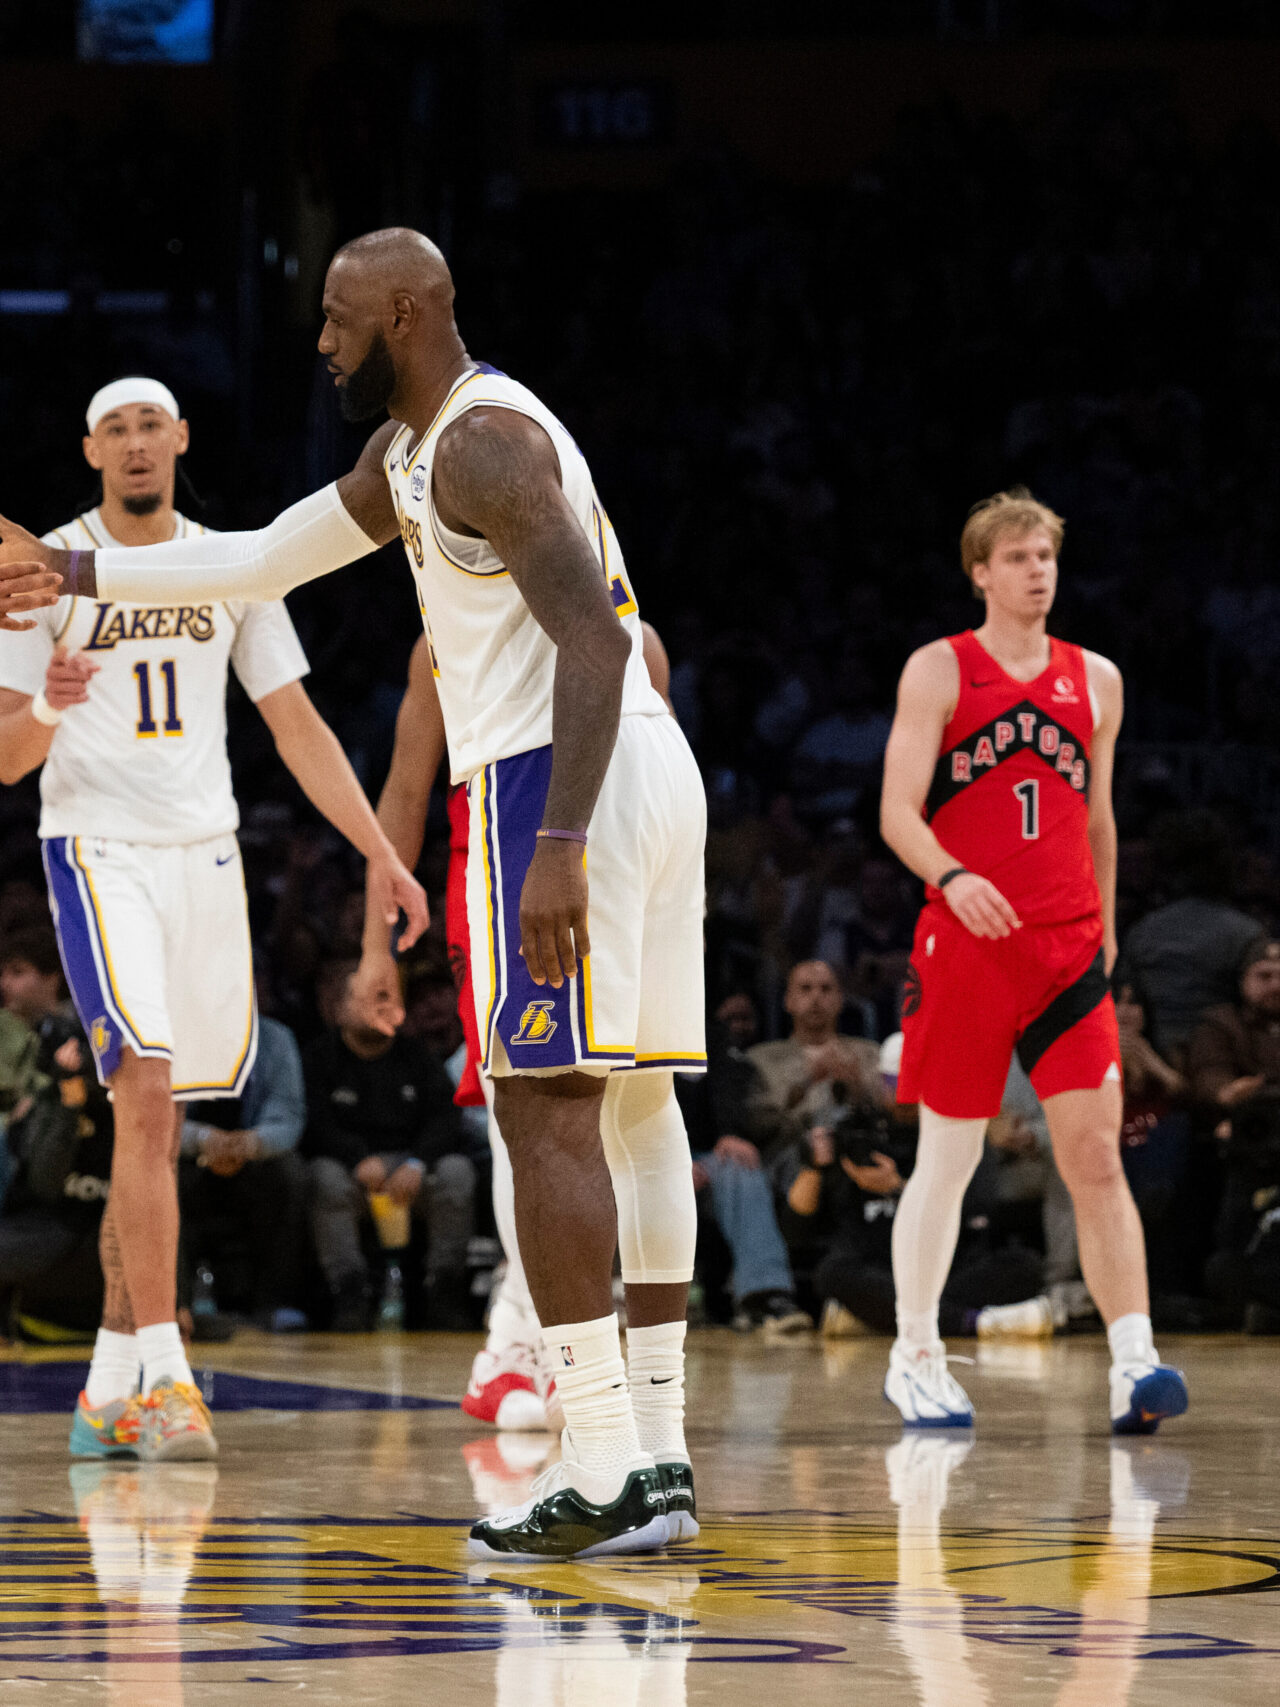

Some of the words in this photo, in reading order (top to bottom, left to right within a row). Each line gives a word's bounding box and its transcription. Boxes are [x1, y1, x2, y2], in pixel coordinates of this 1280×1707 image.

[81, 602, 216, 652] LAKERS
[132, 657, 184, 739] 11
[951, 712, 1086, 790] RAPTORS
[1012, 778, 1040, 841] 1
